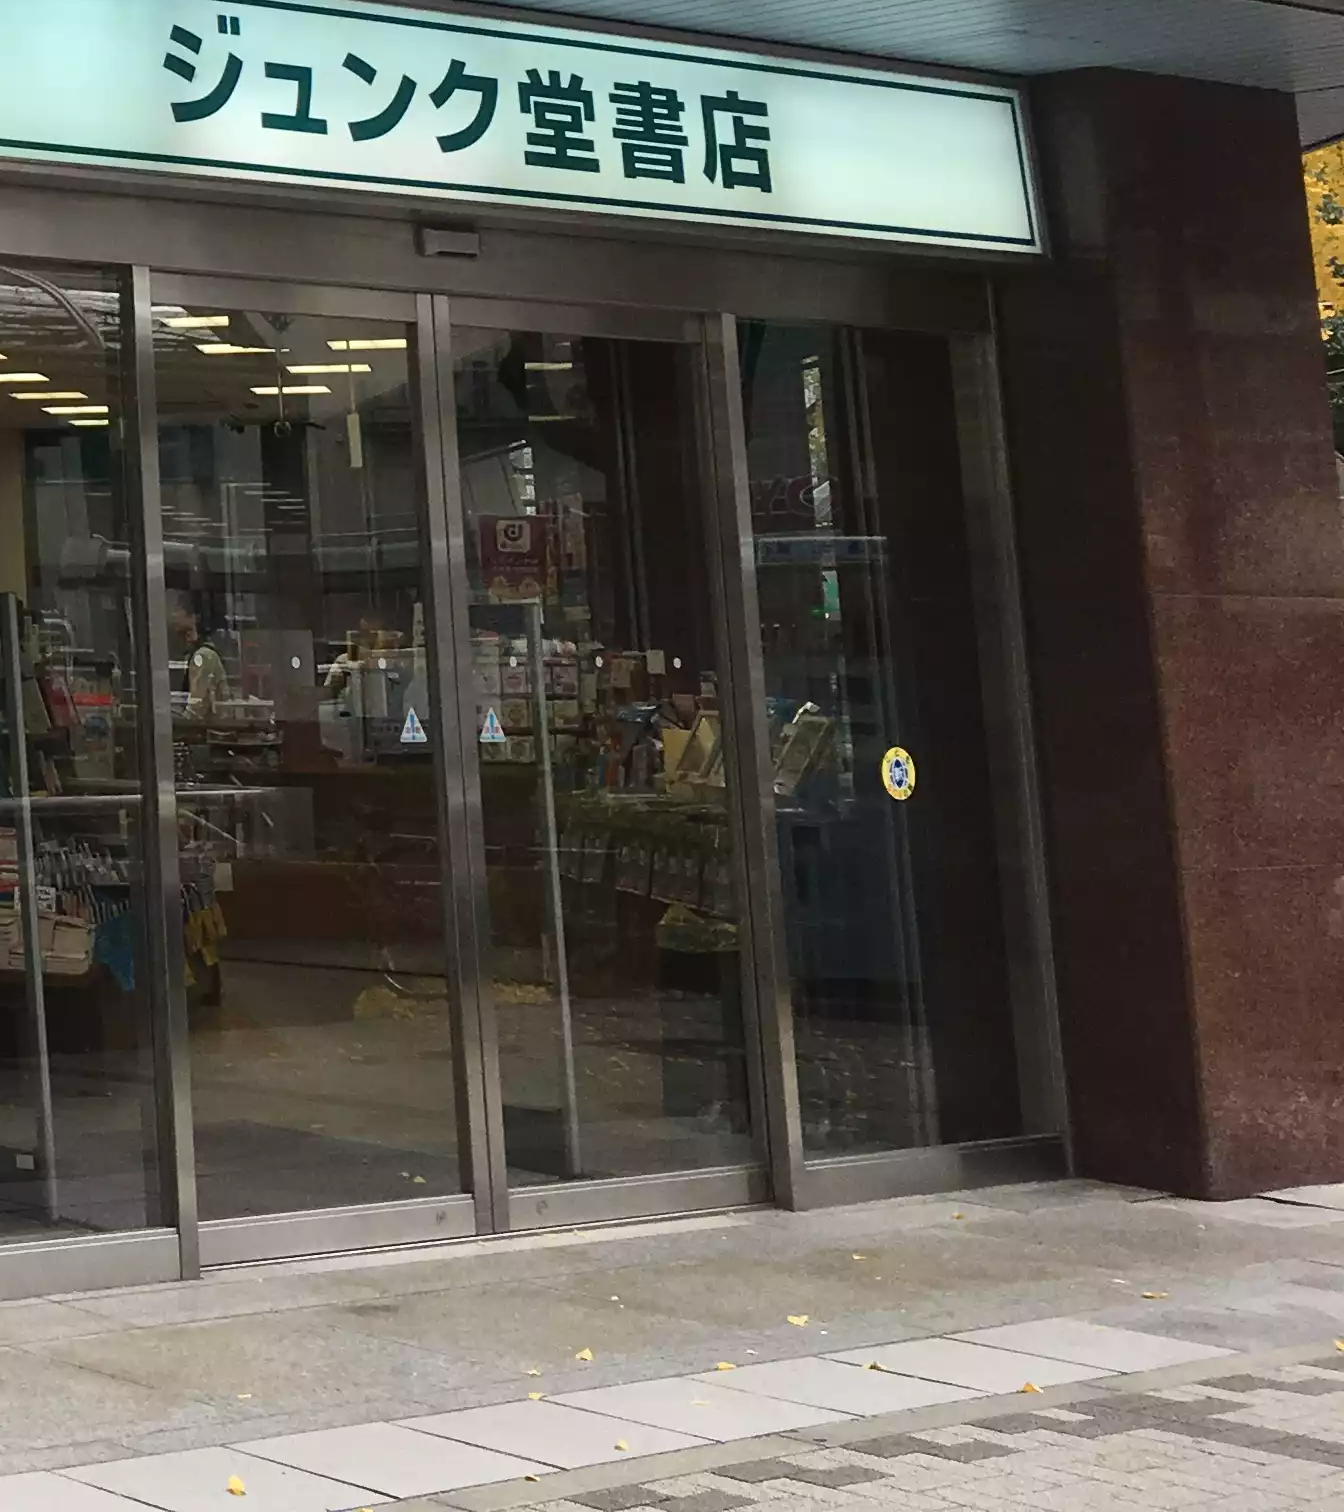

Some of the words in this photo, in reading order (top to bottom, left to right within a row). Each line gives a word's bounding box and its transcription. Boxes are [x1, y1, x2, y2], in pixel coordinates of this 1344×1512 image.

[162, 16, 772, 193] ジュンク堂書店
